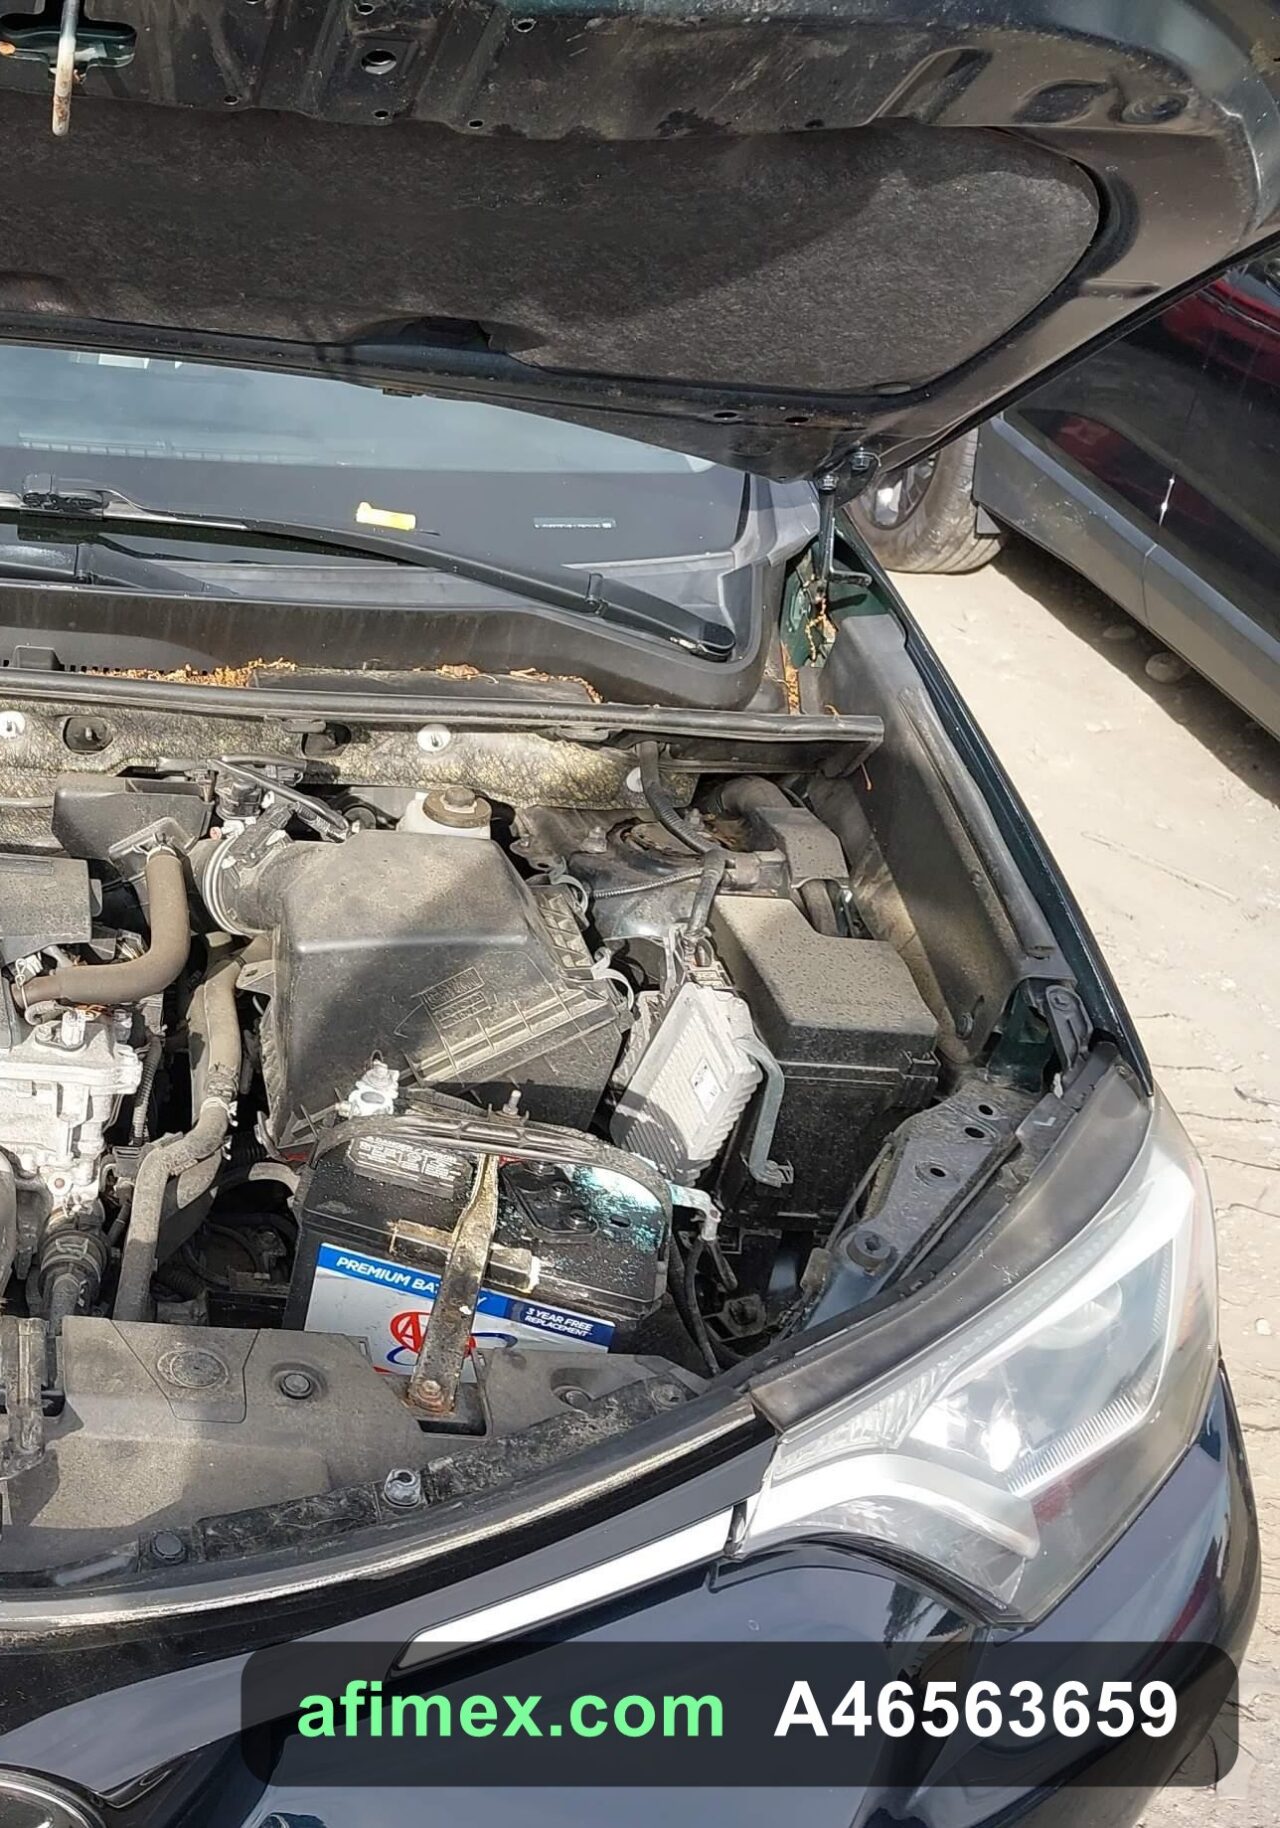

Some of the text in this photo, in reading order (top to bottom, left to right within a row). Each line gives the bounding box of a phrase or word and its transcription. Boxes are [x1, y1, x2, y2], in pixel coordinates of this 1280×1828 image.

[336, 1257, 412, 1287] PREMIUM
[526, 1307, 594, 1331] 3 YEAR FREE
